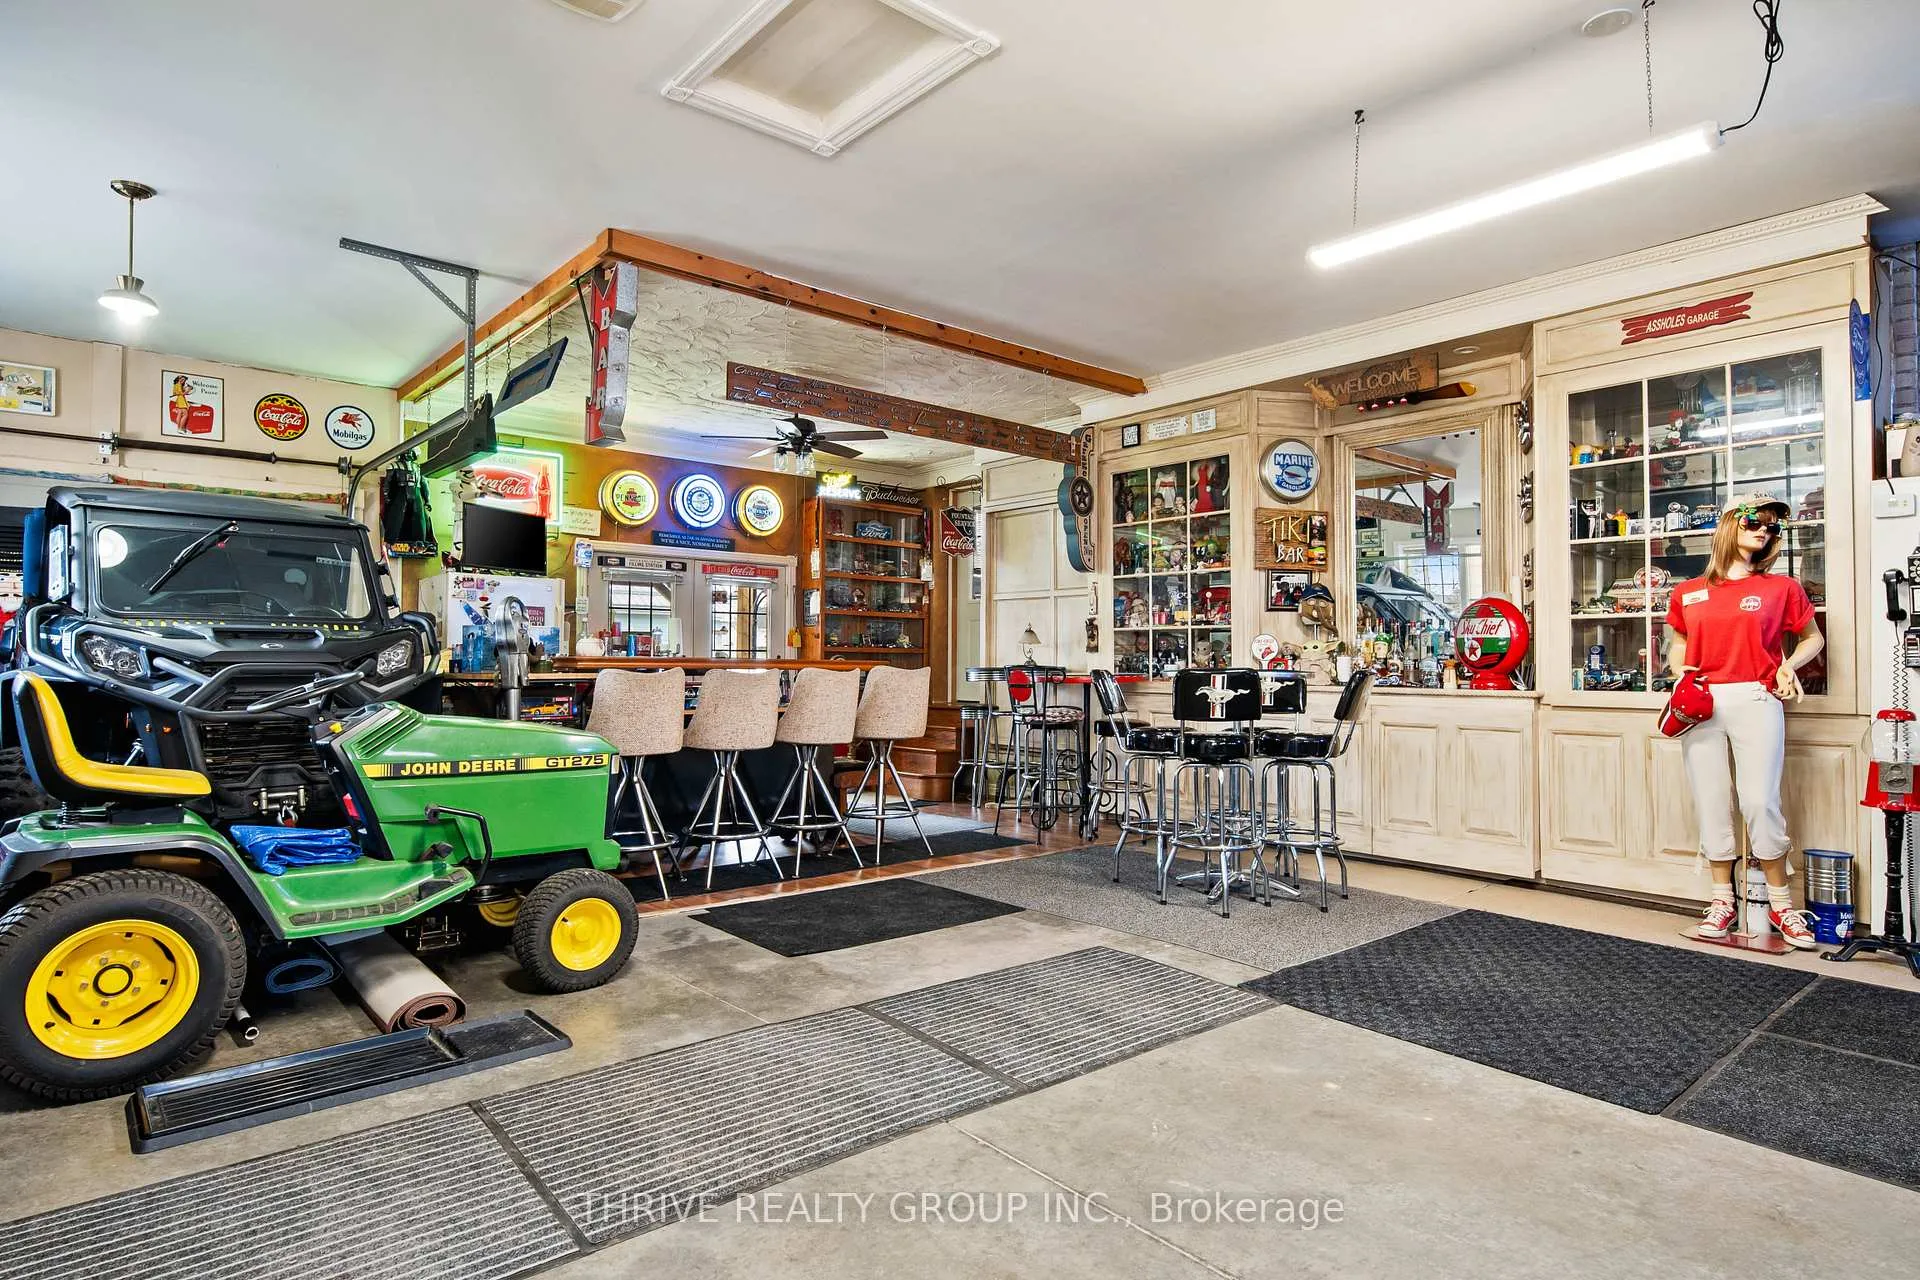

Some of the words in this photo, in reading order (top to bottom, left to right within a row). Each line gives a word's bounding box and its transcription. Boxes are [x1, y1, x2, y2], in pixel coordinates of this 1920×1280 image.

[1646, 313, 1686, 333] ASSHOLES
[1686, 310, 1720, 325] GARAGE
[596, 307, 611, 410] BAR
[1331, 365, 1419, 397] WELCOME
[258, 409, 303, 426] Coca-Cola
[332, 428, 368, 441] Mobilgas
[1275, 453, 1314, 468] MARINE
[861, 485, 920, 505] Budweiser
[1281, 482, 1307, 492] GASOLINE
[860, 526, 888, 539] Ford
[1263, 515, 1310, 544] TIKI
[942, 535, 976, 550] Coca-Cola
[1276, 543, 1304, 564] BAR
[1476, 618, 1504, 636] Chief
[401, 762, 451, 777] JOHN
[458, 758, 516, 774] DEERE
[545, 754, 605, 769] GT275
